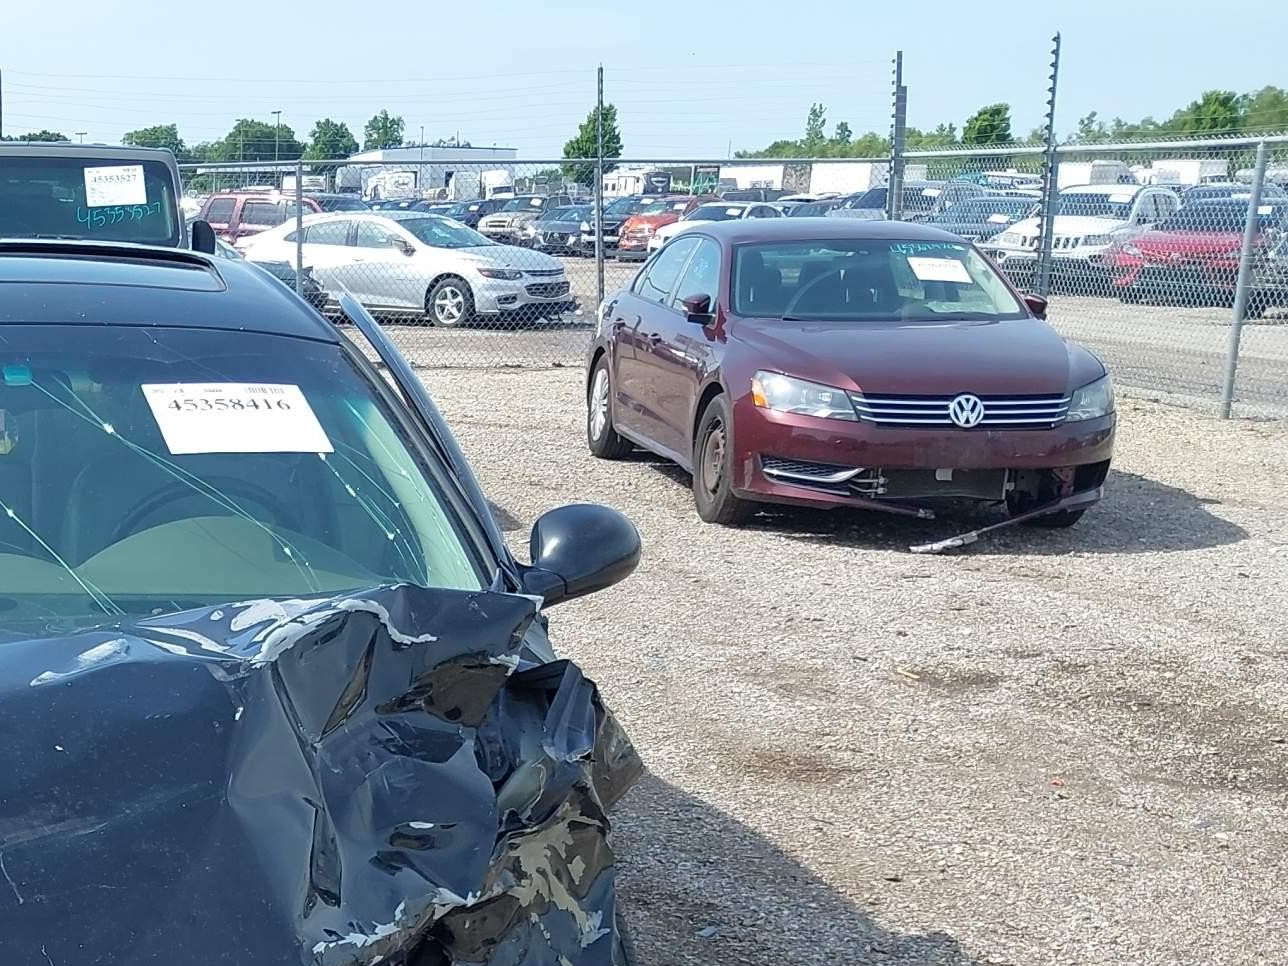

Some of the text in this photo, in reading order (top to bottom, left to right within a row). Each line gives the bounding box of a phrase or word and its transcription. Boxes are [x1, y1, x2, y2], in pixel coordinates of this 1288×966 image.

[91, 173, 137, 183] 45353527
[76, 201, 161, 230] 45353527
[168, 397, 292, 412] 45358416
